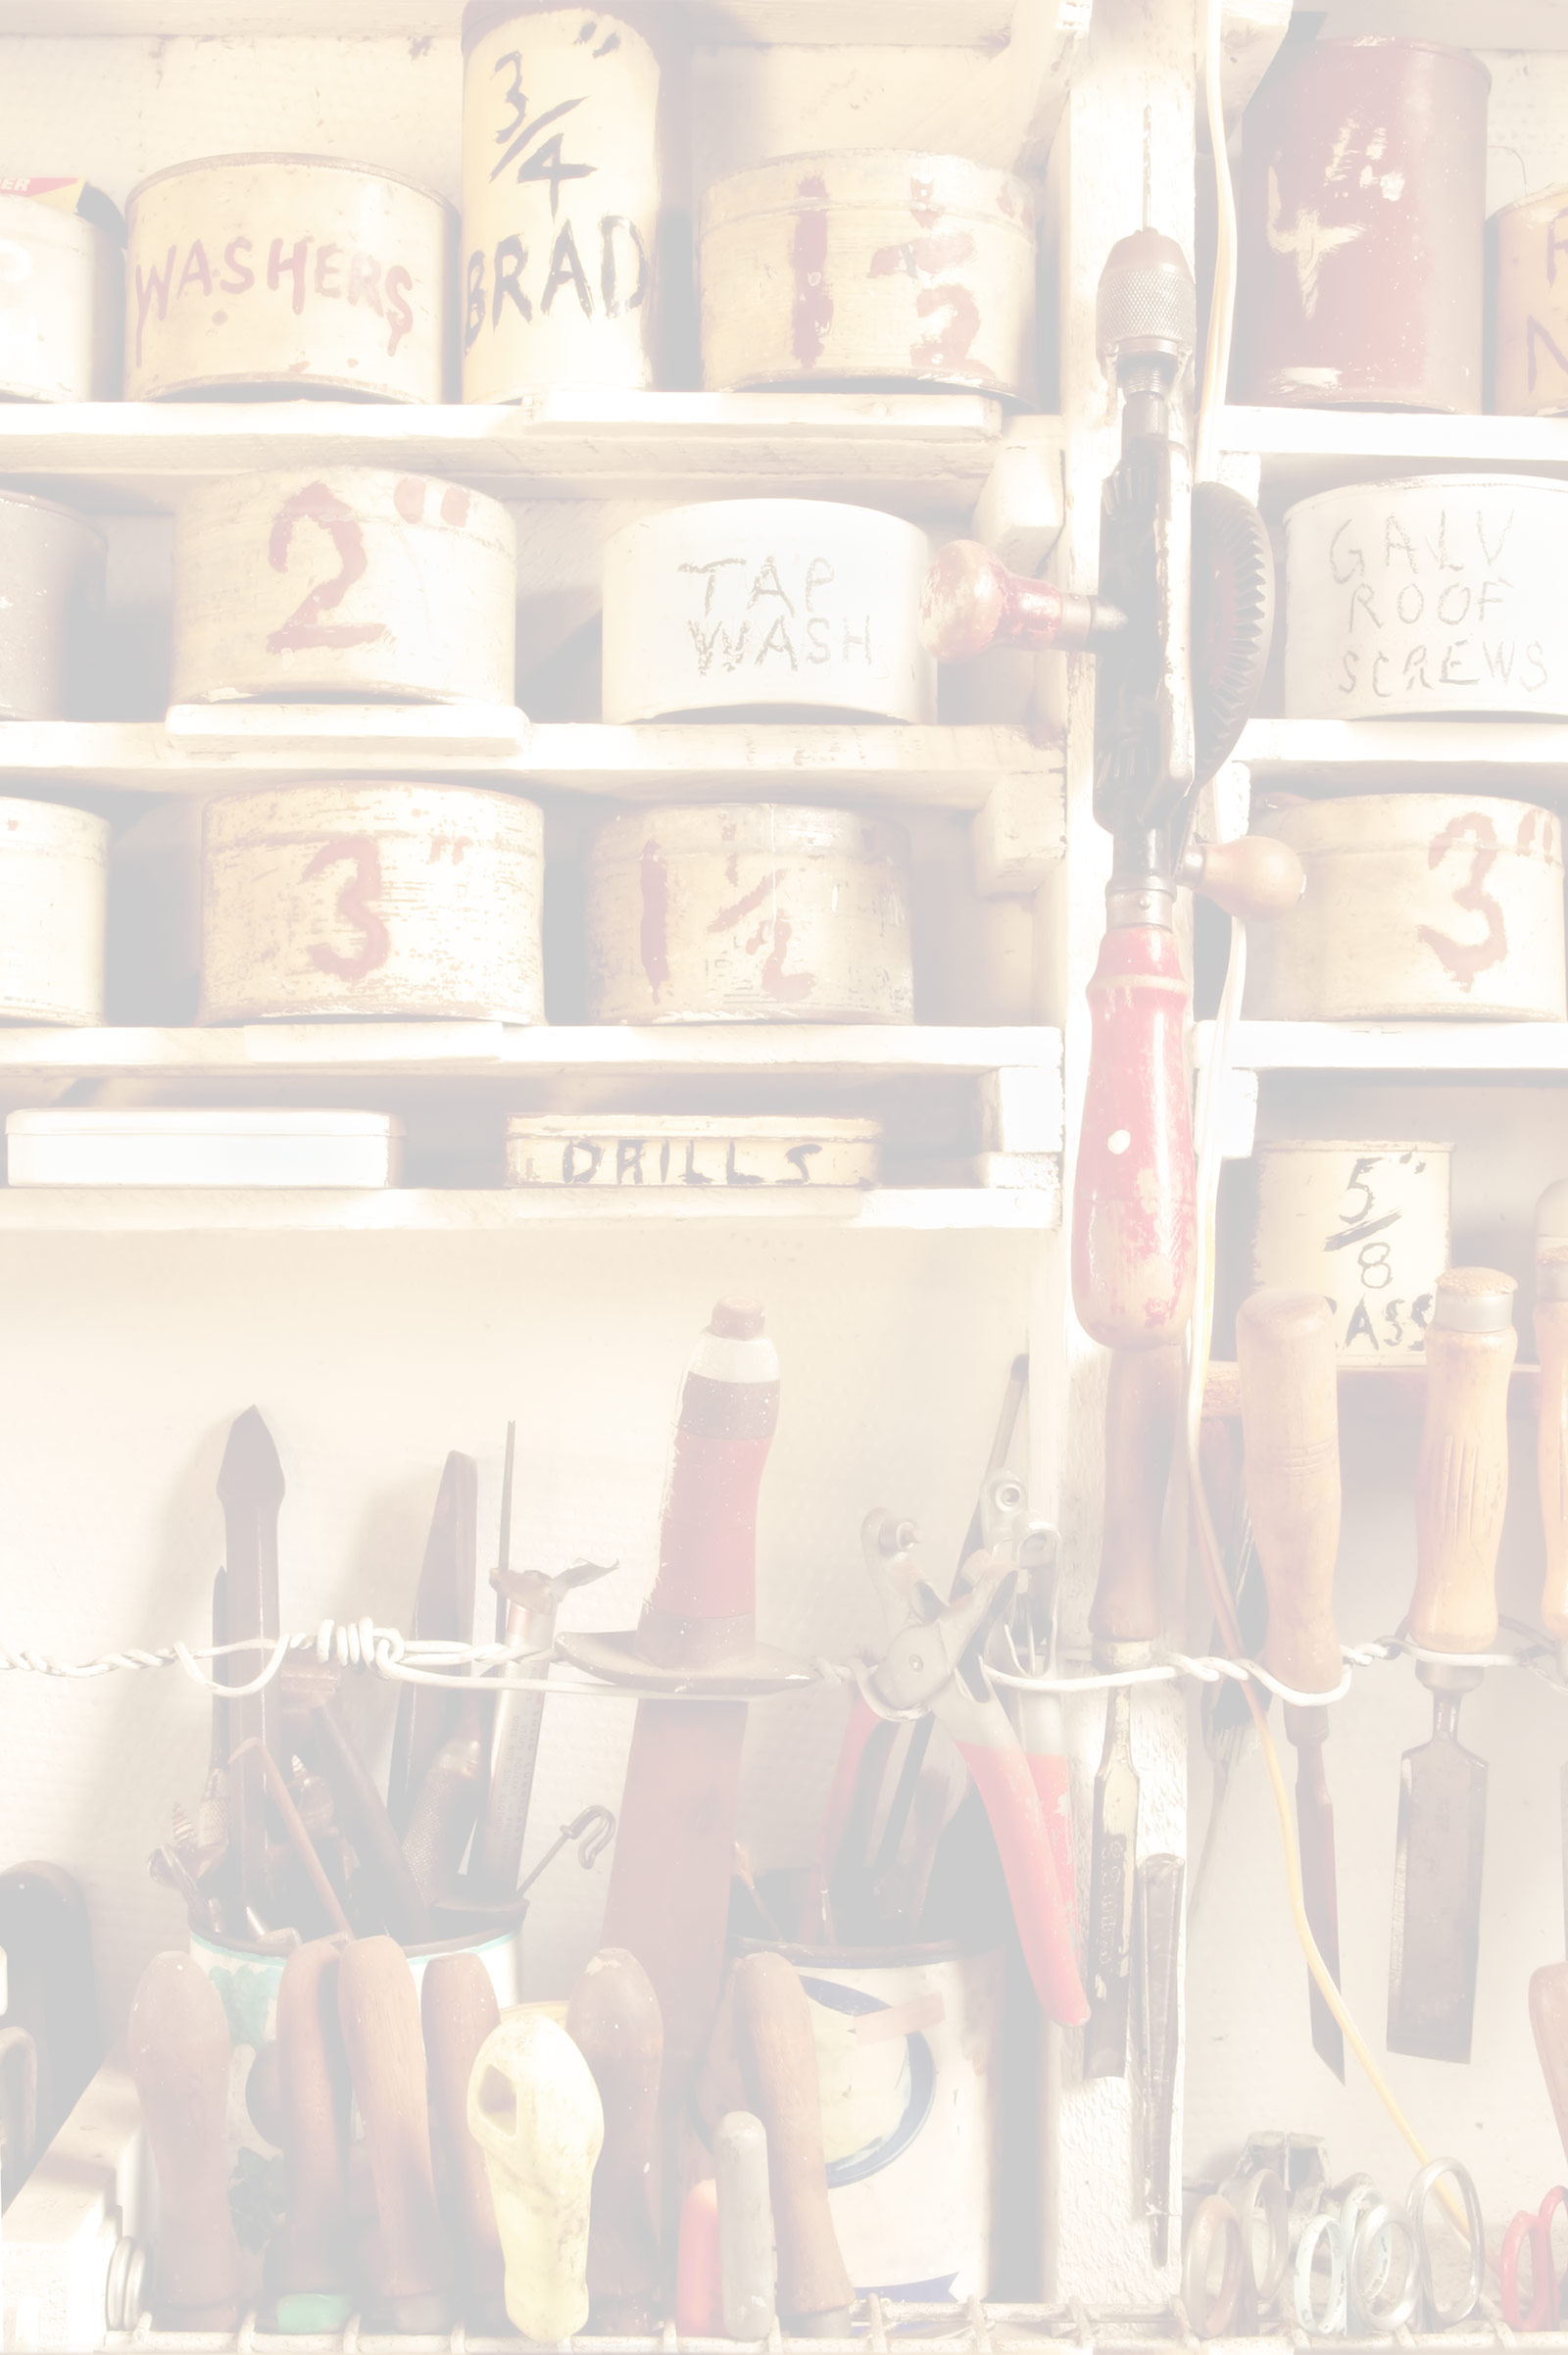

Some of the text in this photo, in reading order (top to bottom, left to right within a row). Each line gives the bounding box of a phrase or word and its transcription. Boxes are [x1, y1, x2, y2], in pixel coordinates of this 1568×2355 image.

[135, 235, 413, 368] WASHERS
[465, 211, 651, 358] BRAD
[1329, 508, 1516, 584] GALV
[676, 556, 835, 617] TAP
[1348, 576, 1516, 634] ROOF
[686, 613, 872, 676] WASH
[1338, 638, 1548, 698] SCREWS
[562, 1137, 824, 1186] DRILLS
[527, 1708, 539, 1751] SOLID
[514, 1762, 532, 1842] LUBRICANT
